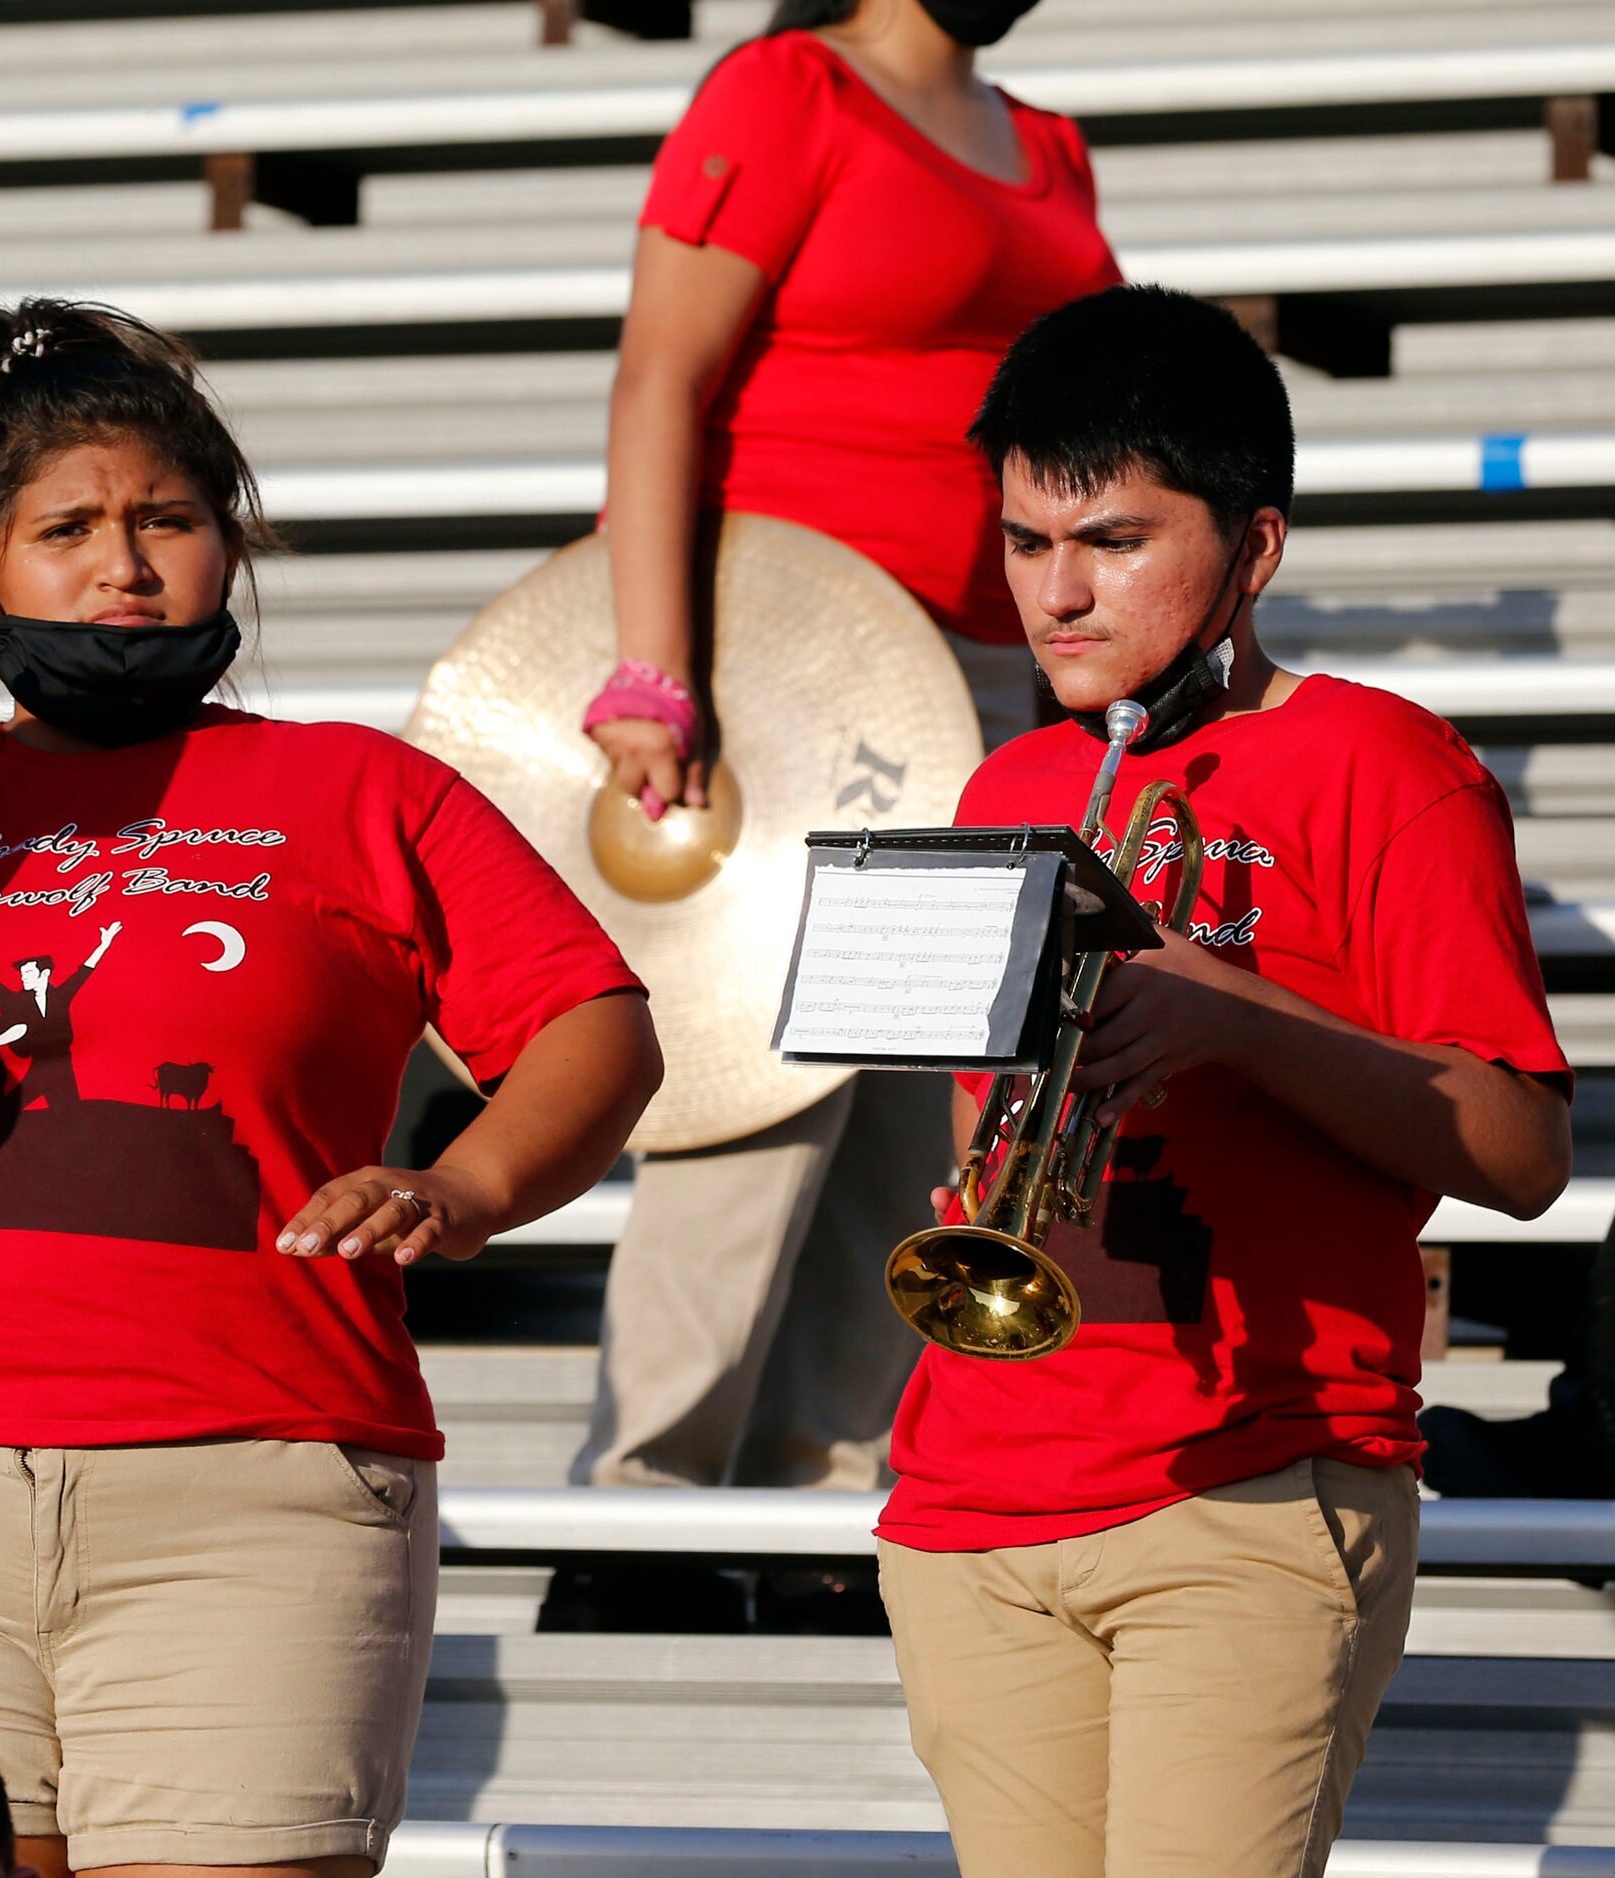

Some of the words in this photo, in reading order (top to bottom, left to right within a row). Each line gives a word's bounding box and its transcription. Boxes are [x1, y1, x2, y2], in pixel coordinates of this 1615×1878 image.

[110, 817, 287, 860] Spruce
[121, 867, 272, 902] Band
[1187, 907, 1263, 946] nd
